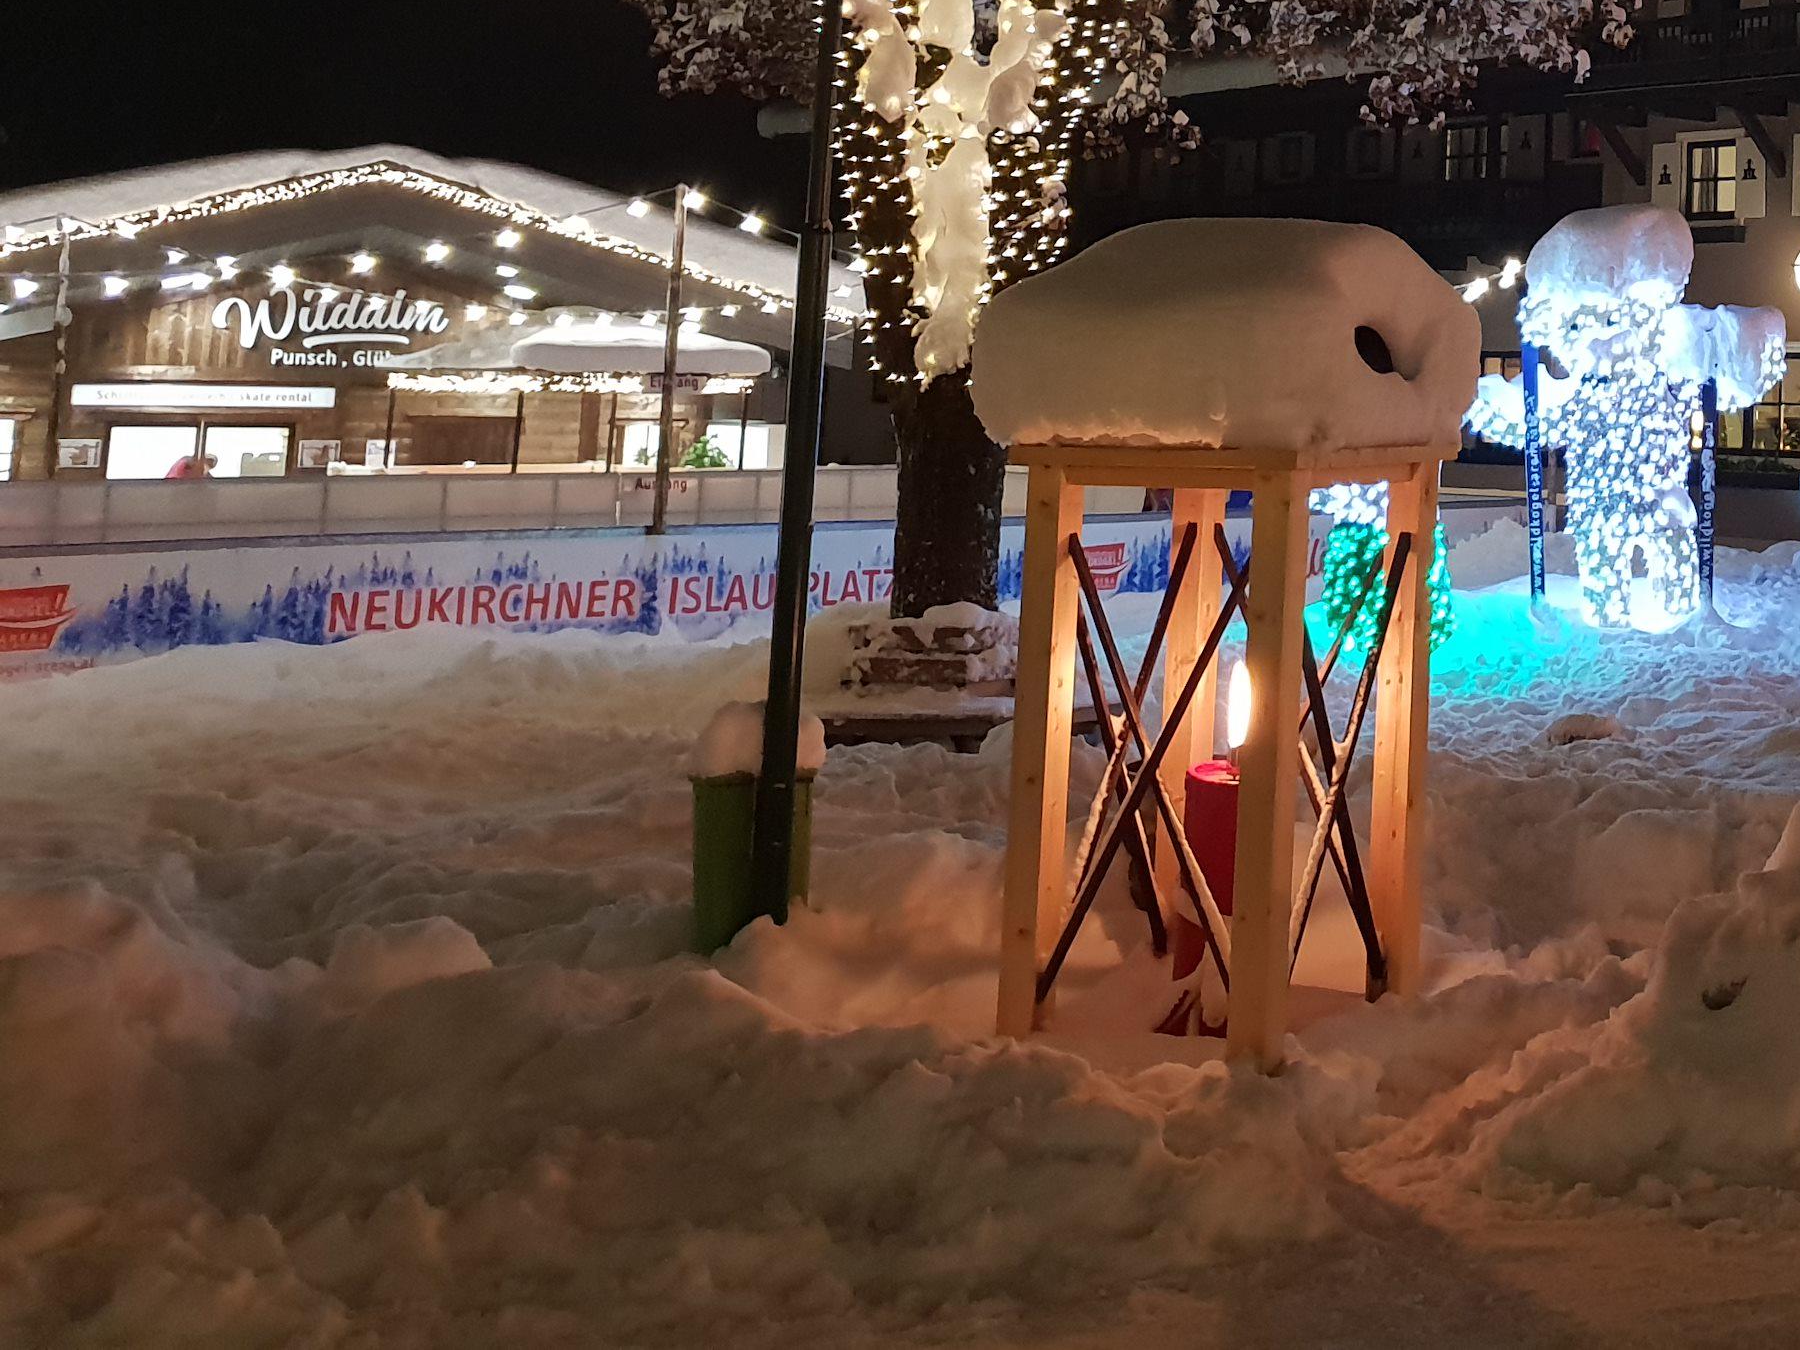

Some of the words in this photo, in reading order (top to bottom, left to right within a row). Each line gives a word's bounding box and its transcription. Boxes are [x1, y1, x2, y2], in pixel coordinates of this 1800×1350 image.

[211, 286, 449, 349] Wildalm
[270, 348, 337, 367] Punsch
[650, 375, 698, 391] Eiang
[275, 391, 312, 403] rental
[328, 580, 637, 633] NEUKIRCHNER
[668, 568, 894, 615] ISLAUPLATZ
